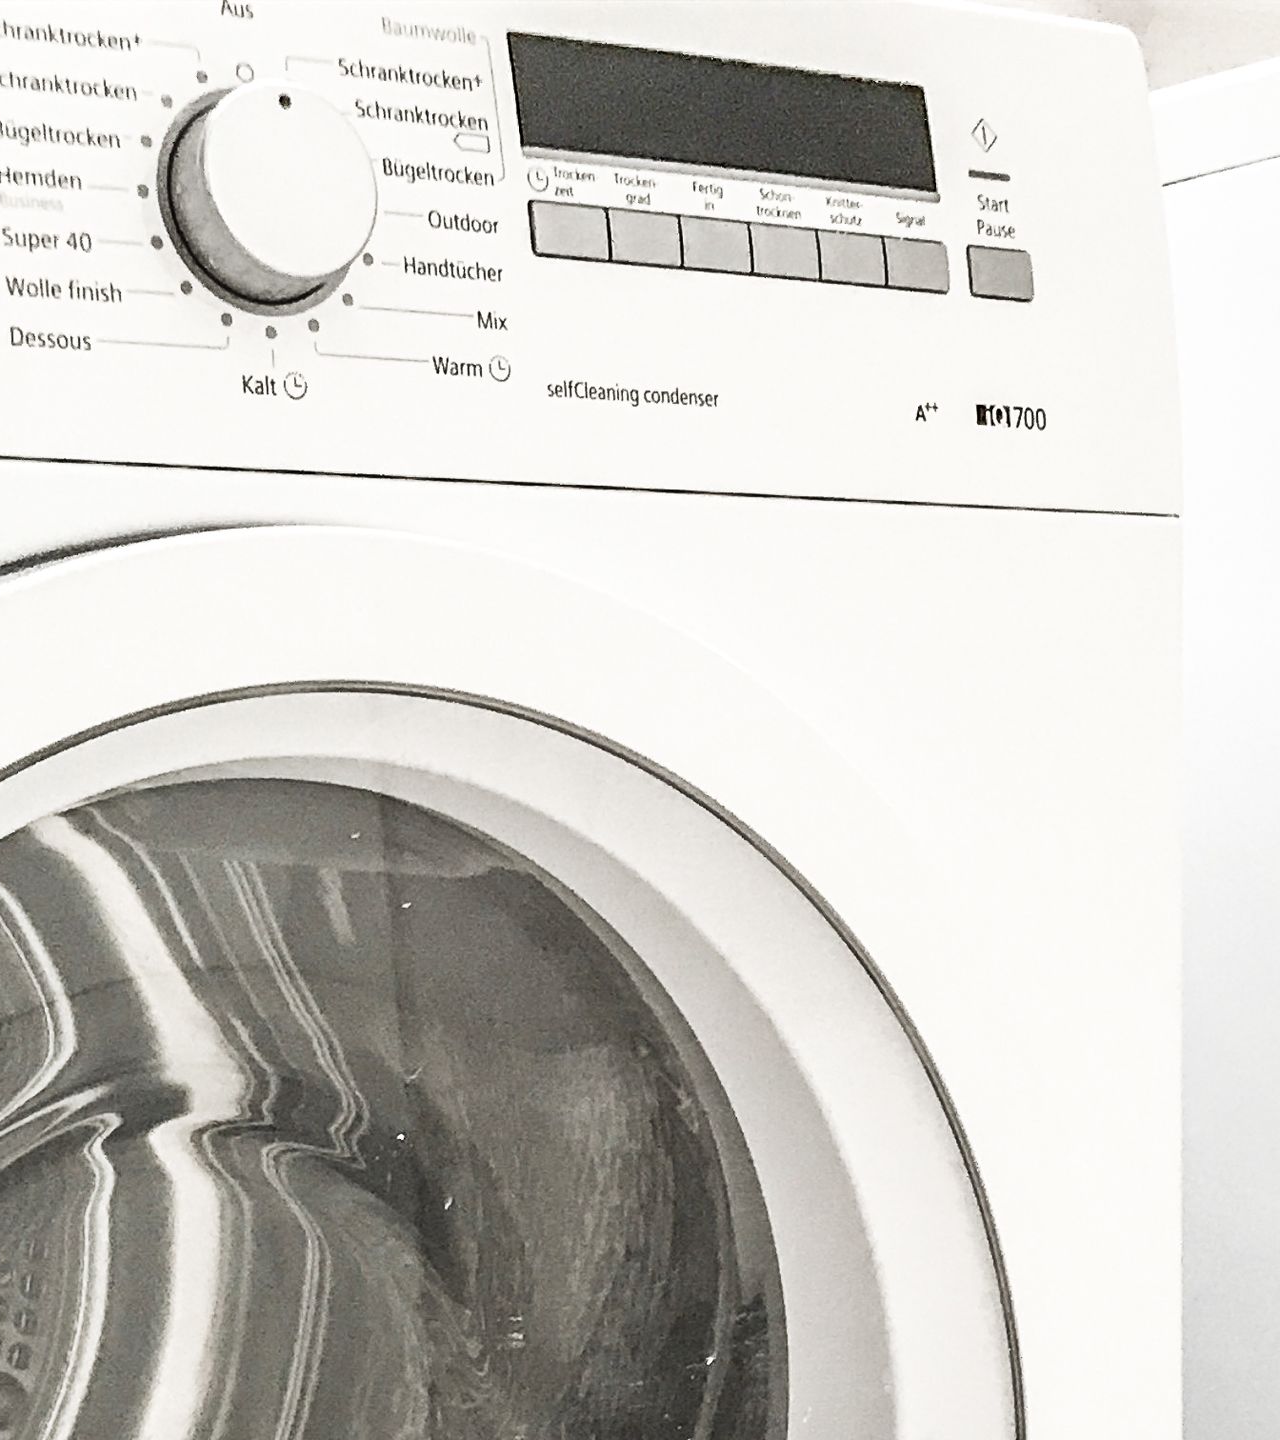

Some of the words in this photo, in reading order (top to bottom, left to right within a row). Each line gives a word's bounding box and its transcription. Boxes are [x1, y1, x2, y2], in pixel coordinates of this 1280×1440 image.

[221, 0, 253, 19] Aus
[381, 16, 476, 46] Baumwolle
[355, 99, 488, 131] Schranktrocken
[383, 157, 494, 186] Bügeltrocken
[625, 193, 651, 206] grad
[692, 180, 724, 199] Fertig
[977, 194, 1009, 213] Start
[428, 210, 498, 234] Outdoor
[830, 213, 862, 226] schutz
[896, 212, 925, 228] Signal
[977, 219, 1015, 239] Pause
[2, 227, 59, 252] Super
[66, 232, 92, 253] 40
[404, 256, 503, 282] Handtücher
[5, 276, 62, 299] Wolle
[69, 280, 122, 303] finish
[477, 311, 508, 331] Mix
[10, 326, 91, 351] Dessous
[432, 356, 482, 378] Warm
[242, 375, 277, 396] Kalt
[547, 380, 639, 407] selfCleaning
[644, 387, 718, 407] condenser
